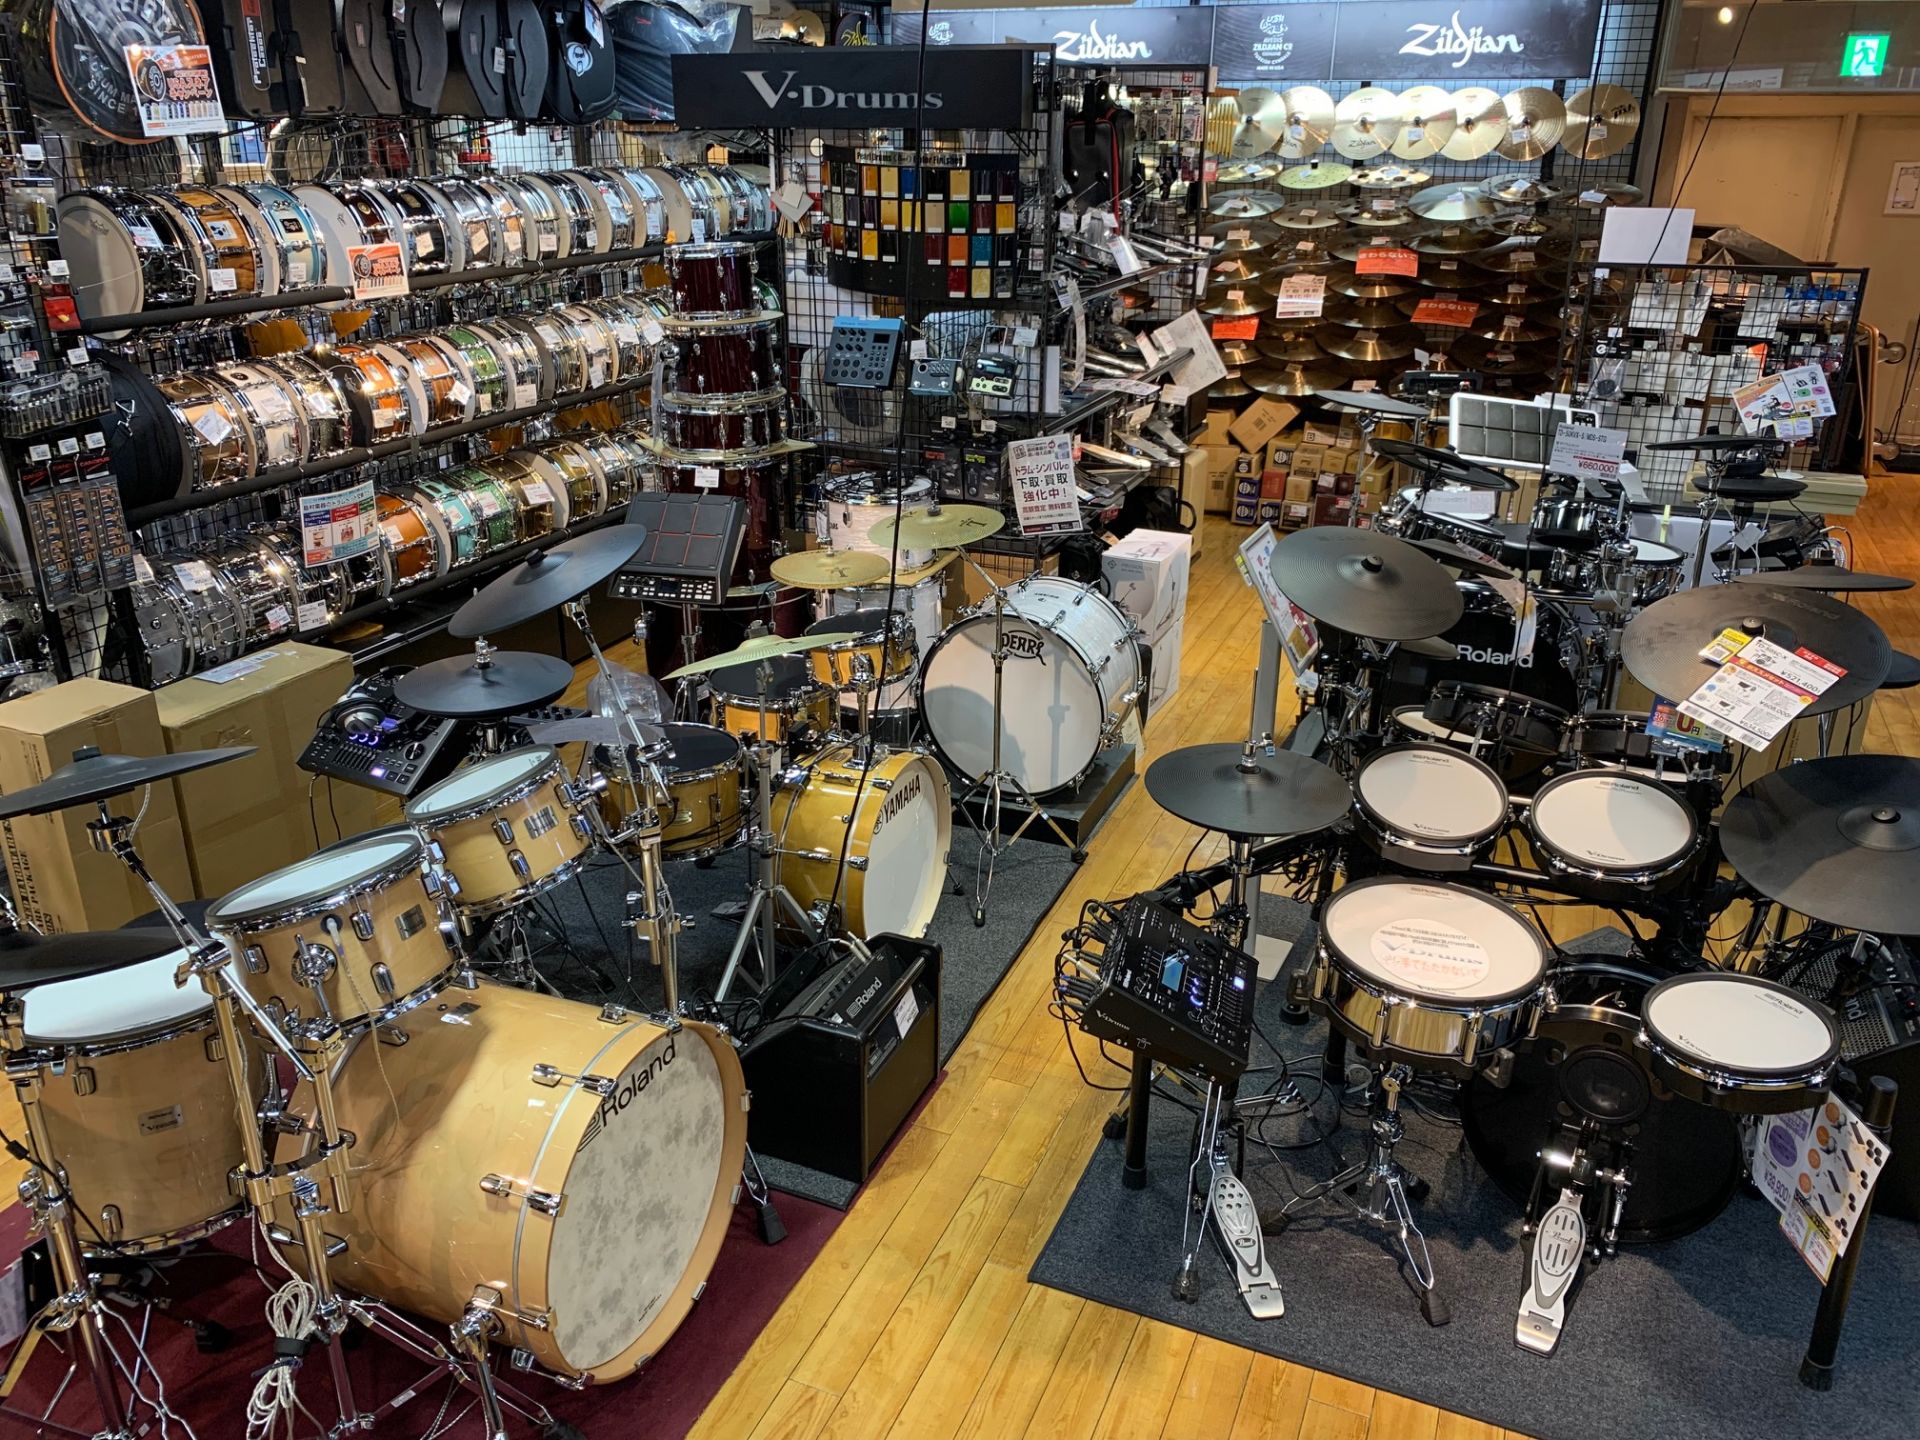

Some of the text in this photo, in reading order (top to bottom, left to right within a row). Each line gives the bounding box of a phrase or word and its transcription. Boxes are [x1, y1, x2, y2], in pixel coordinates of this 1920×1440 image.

[1052, 18, 1153, 61] Zildjian
[1253, 43, 1282, 51] ZILDJIAN
[1399, 10, 1525, 68] Zildjian
[87, 79, 126, 114] SINCE
[1017, 473, 1068, 489] 下取・買取
[1456, 644, 1535, 668] Roland
[883, 773, 921, 824] YAMAHA
[855, 976, 882, 1010] Roland
[1096, 1009, 1130, 1030] V-Drums
[601, 1037, 676, 1128] Roland
